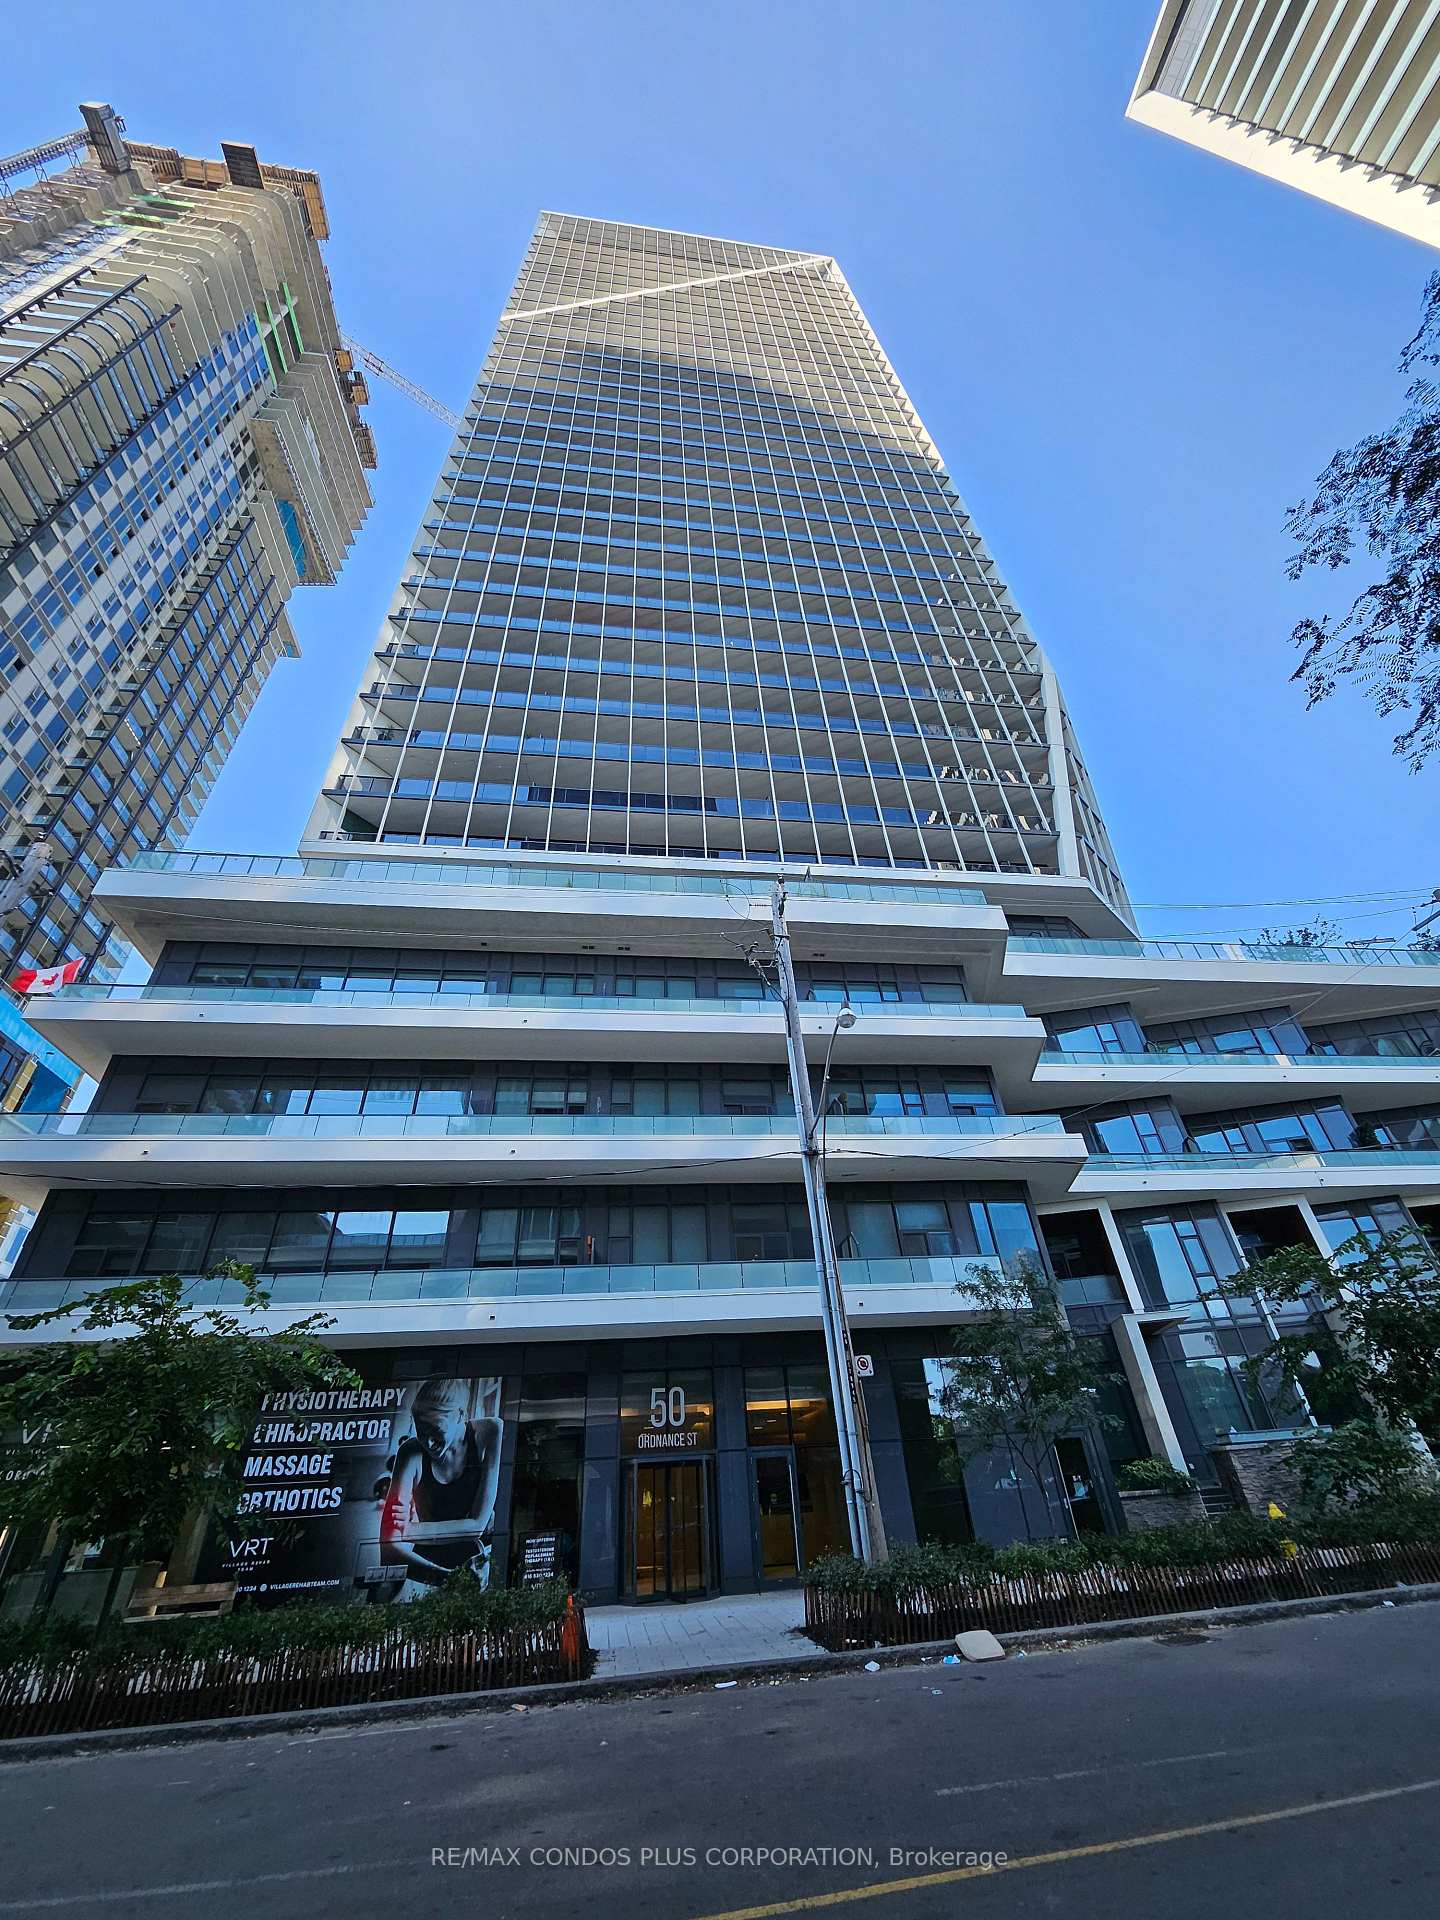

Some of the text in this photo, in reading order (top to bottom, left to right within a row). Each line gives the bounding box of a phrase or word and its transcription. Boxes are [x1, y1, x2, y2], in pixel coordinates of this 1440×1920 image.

[650, 1386, 686, 1428] 50
[253, 1419, 391, 1444] CHIROPRACTOR
[638, 1431, 698, 1449] ORDNANCE ST
[243, 1453, 334, 1477] MASSAGE
[236, 1486, 343, 1515] ORTHOTICS
[230, 1537, 275, 1558] VRT
